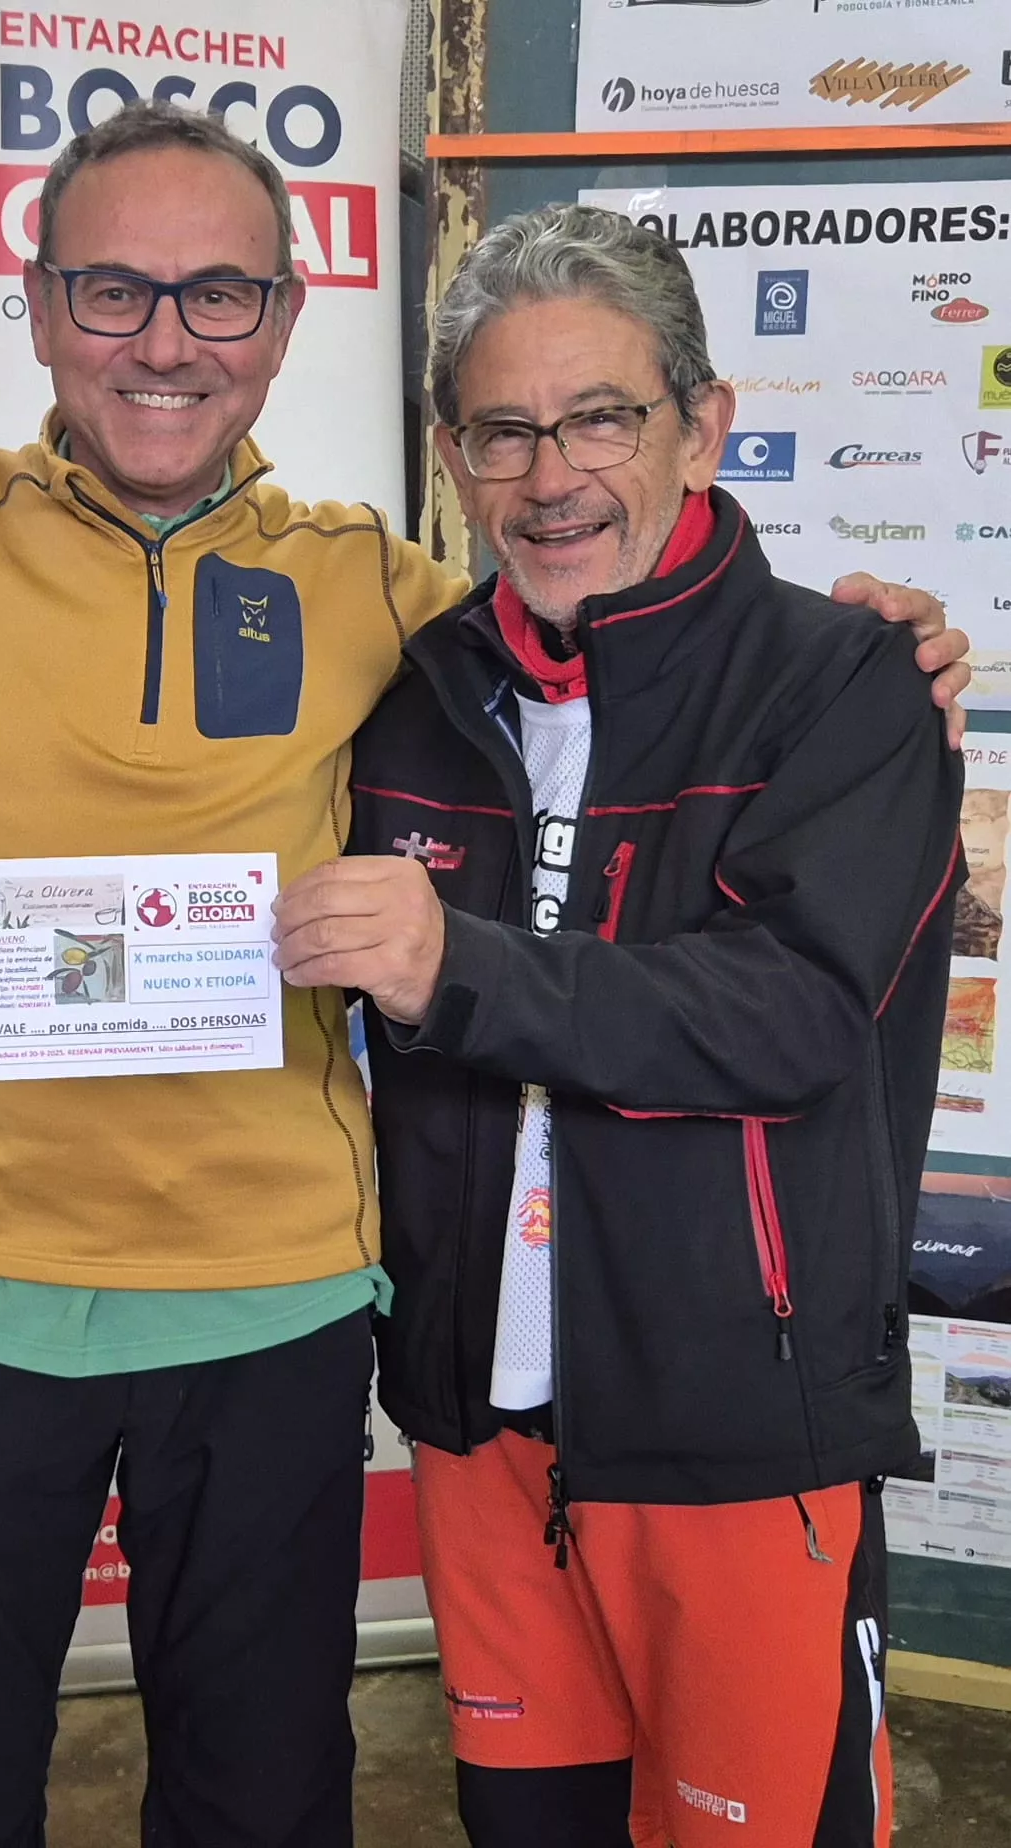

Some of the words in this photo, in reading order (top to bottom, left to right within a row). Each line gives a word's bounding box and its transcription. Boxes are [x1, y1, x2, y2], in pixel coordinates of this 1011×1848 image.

[0, 10, 285, 70] ENTARACHEN
[821, 74, 873, 95] VILLA
[876, 71, 951, 88] VILLERA
[911, 289, 950, 302] FINO
[763, 310, 798, 323] MIGUEL
[940, 306, 983, 319] Ferrer
[852, 370, 947, 387] SAQQARA
[829, 444, 922, 470] Correas
[766, 469, 790, 478] LUNA
[838, 519, 925, 545] seytam
[238, 626, 271, 643] altus
[14, 887, 35, 899] La
[41, 884, 95, 899] Olivera
[188, 890, 248, 905] BOSCO
[188, 905, 255, 922] GLOBAL
[145, 949, 193, 963] marcha
[196, 948, 265, 962] SOLIDARIA
[143, 976, 191, 990] NUENO
[194, 977, 203, 988] X
[206, 972, 256, 988] ETIOPÍA
[49, 1022, 71, 1035] por
[74, 1022, 98, 1033] una
[101, 1018, 148, 1032] comida
[170, 1016, 197, 1029] DOS
[201, 1012, 267, 1027] PERSONAS
